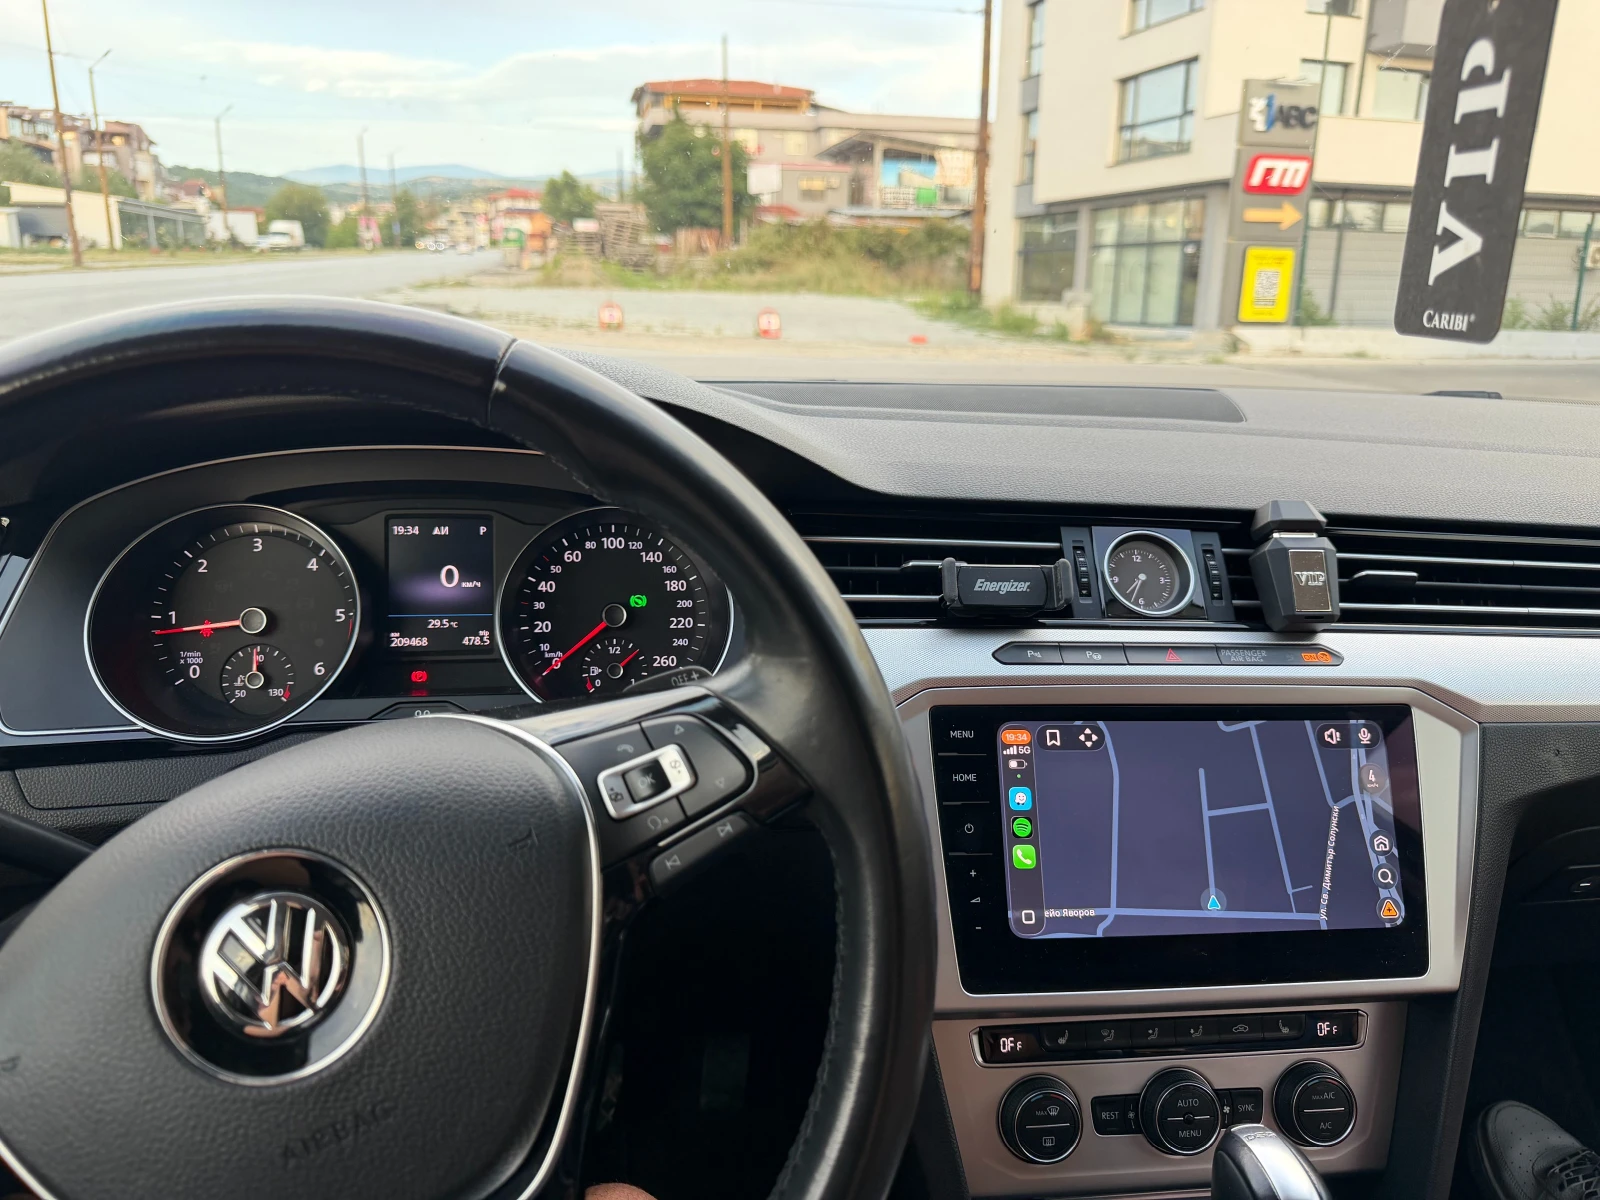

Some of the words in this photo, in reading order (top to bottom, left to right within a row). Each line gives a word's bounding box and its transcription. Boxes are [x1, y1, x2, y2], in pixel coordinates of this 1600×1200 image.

[1428, 38, 1512, 286] VIP
[392, 525, 419, 536] 19:34
[479, 526, 487, 536] P
[252, 537, 263, 552] 3
[585, 541, 597, 549] 80
[601, 537, 625, 549] 100
[628, 541, 643, 550] 120
[564, 550, 582, 562] 60
[640, 551, 663, 563] 140
[1131, 555, 1142, 563] 12
[197, 559, 208, 573] 2
[306, 557, 319, 572] 4
[550, 565, 562, 574] 50
[662, 565, 677, 574] 160
[440, 564, 460, 588] 0
[1294, 571, 1326, 586] VIP
[538, 580, 556, 592] 40
[664, 580, 687, 592] 180
[533, 601, 545, 610] 30
[676, 600, 693, 608] 200
[1138, 597, 1144, 605] 6
[168, 610, 176, 625] 1
[335, 608, 346, 622] 5
[533, 621, 552, 633] 20
[669, 617, 693, 629] 220
[389, 637, 429, 647] 209468
[462, 636, 490, 646] 478.5
[672, 638, 689, 646] 240
[539, 643, 550, 651] 10
[608, 646, 621, 654] 1/2
[544, 651, 563, 659] km/h
[1220, 649, 1267, 657] PASSENGER
[652, 655, 677, 667] 260
[189, 665, 201, 679] 0
[314, 662, 325, 676] 6
[594, 679, 601, 687] 0
[235, 689, 247, 698] 50
[268, 688, 284, 697] 130
[949, 730, 974, 739] MENU
[1005, 733, 1028, 741] 19:34
[1018, 746, 1031, 754] 5G
[639, 772, 656, 789] OK
[952, 773, 977, 782] HOME
[1368, 769, 1376, 782] 4
[1327, 805, 1340, 847] Солунски
[1322, 848, 1336, 891] Димитър
[1062, 908, 1096, 919] Яворов
[1323, 1091, 1336, 1099] A/C
[1177, 1098, 1200, 1109] AUTO
[1237, 1103, 1255, 1113] SYNC
[1101, 1111, 1120, 1120] REST
[1319, 1121, 1333, 1130] A/C
[1178, 1129, 1202, 1138] MENU
